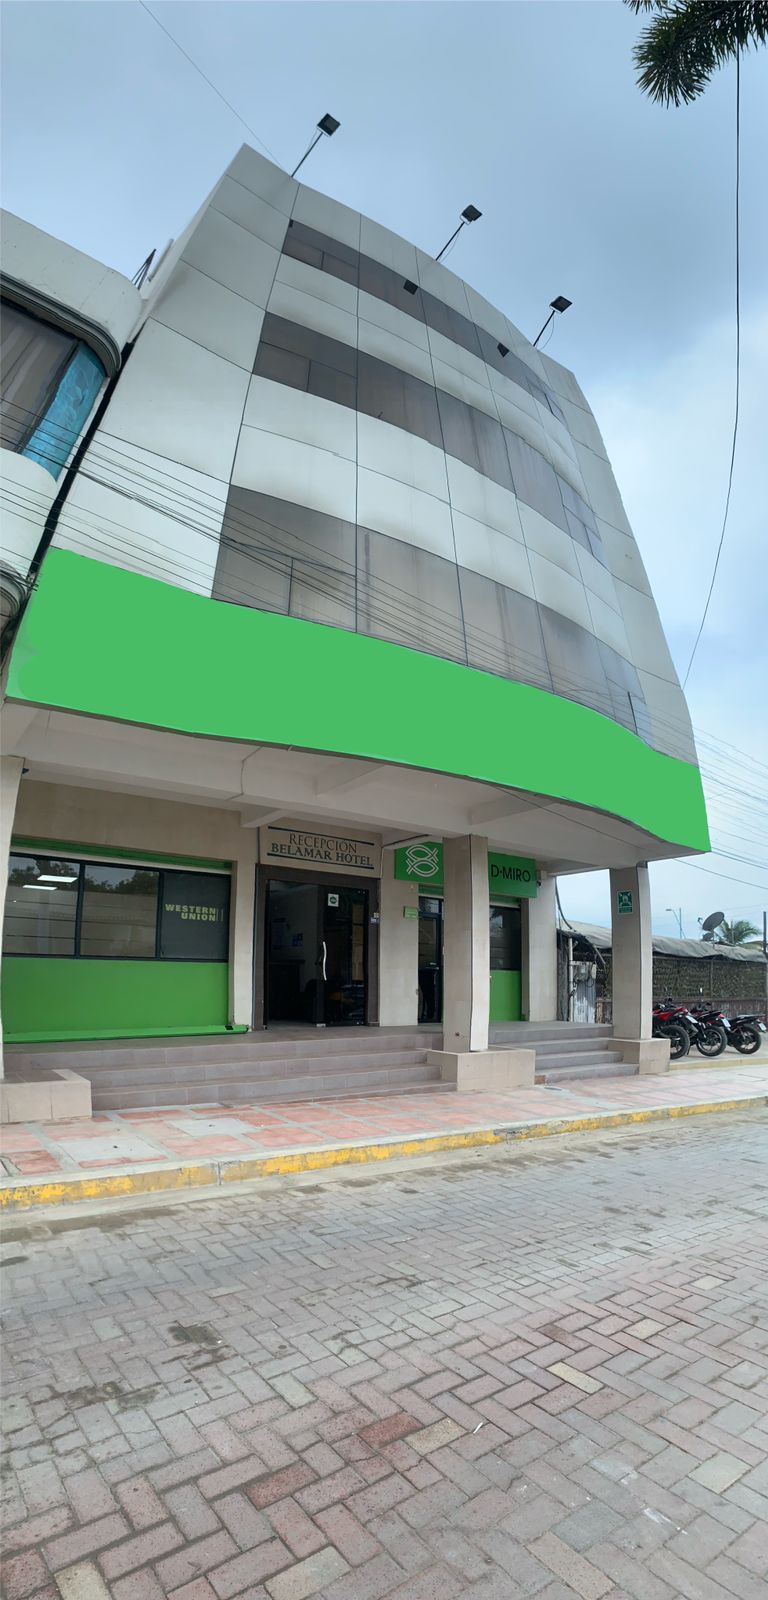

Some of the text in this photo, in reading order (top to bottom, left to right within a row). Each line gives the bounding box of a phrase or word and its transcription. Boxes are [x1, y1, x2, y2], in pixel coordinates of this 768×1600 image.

[271, 843, 373, 866] BELAMAR HOTEL
[165, 904, 216, 914] WESTERN
[181, 912, 216, 921] UNION
